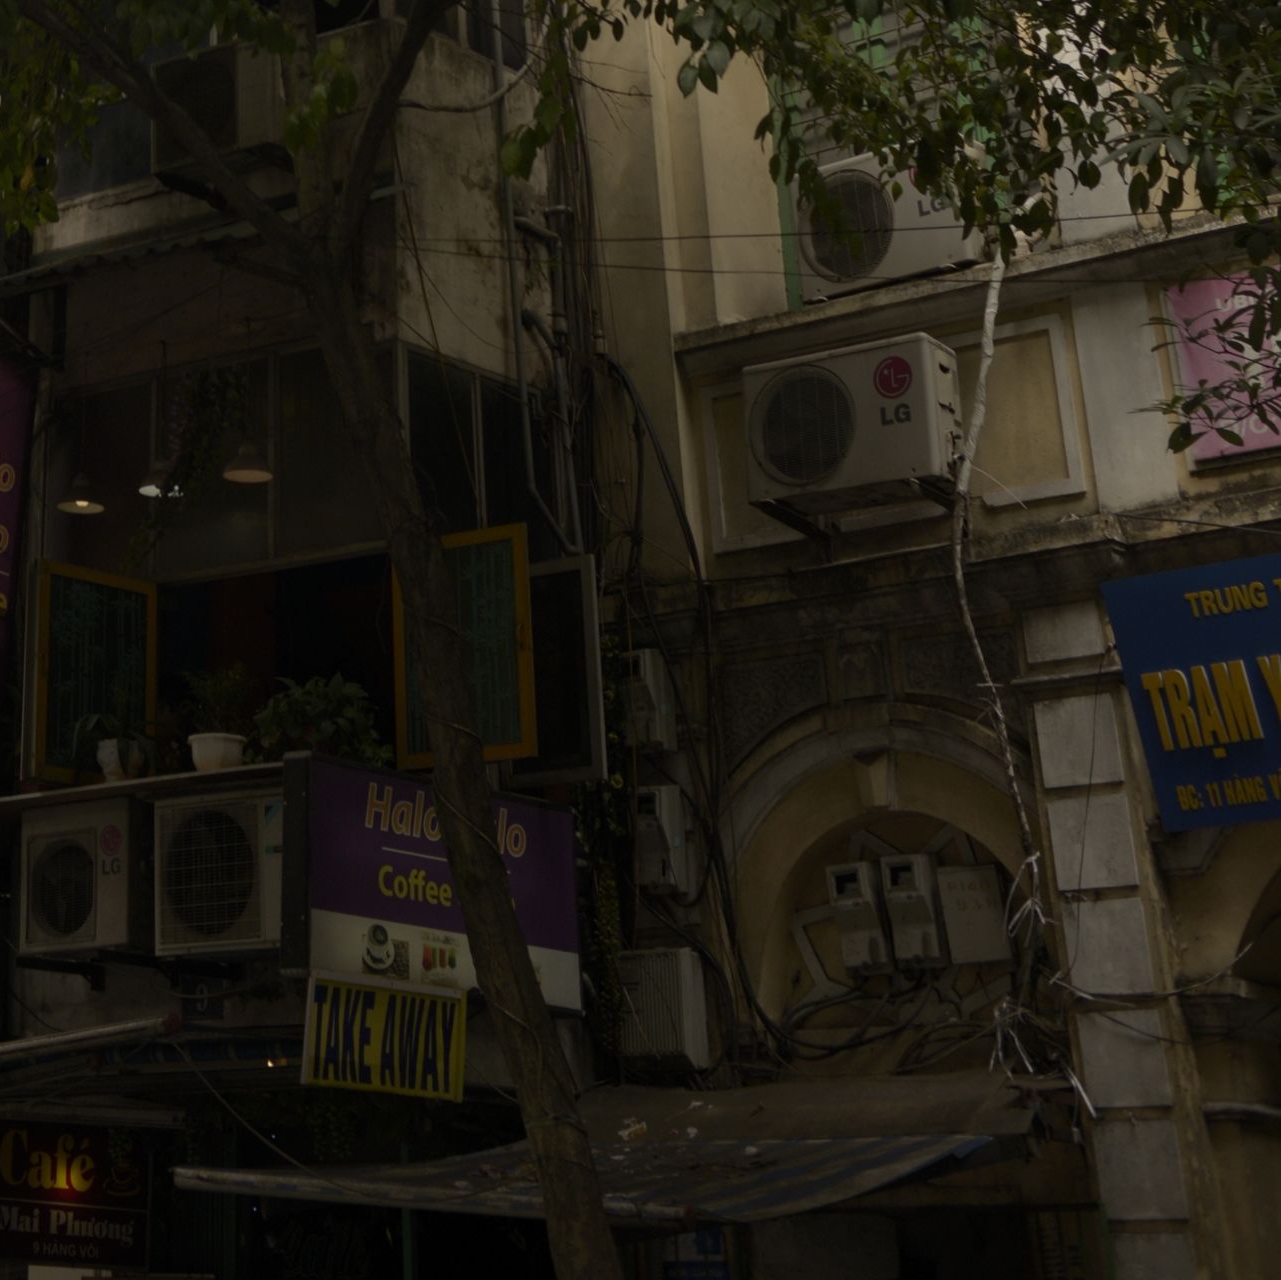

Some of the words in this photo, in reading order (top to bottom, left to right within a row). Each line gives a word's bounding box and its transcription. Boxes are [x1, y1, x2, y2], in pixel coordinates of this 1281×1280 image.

[880, 403, 912, 427] LG
[1184, 581, 1269, 618] TRUNG
[1139, 659, 1265, 758] TRẠM
[365, 782, 443, 841] Halo
[101, 859, 121, 876] LG
[378, 864, 453, 907] Coffee
[313, 985, 375, 1084] TAKE
[380, 994, 456, 1093] AWAY
